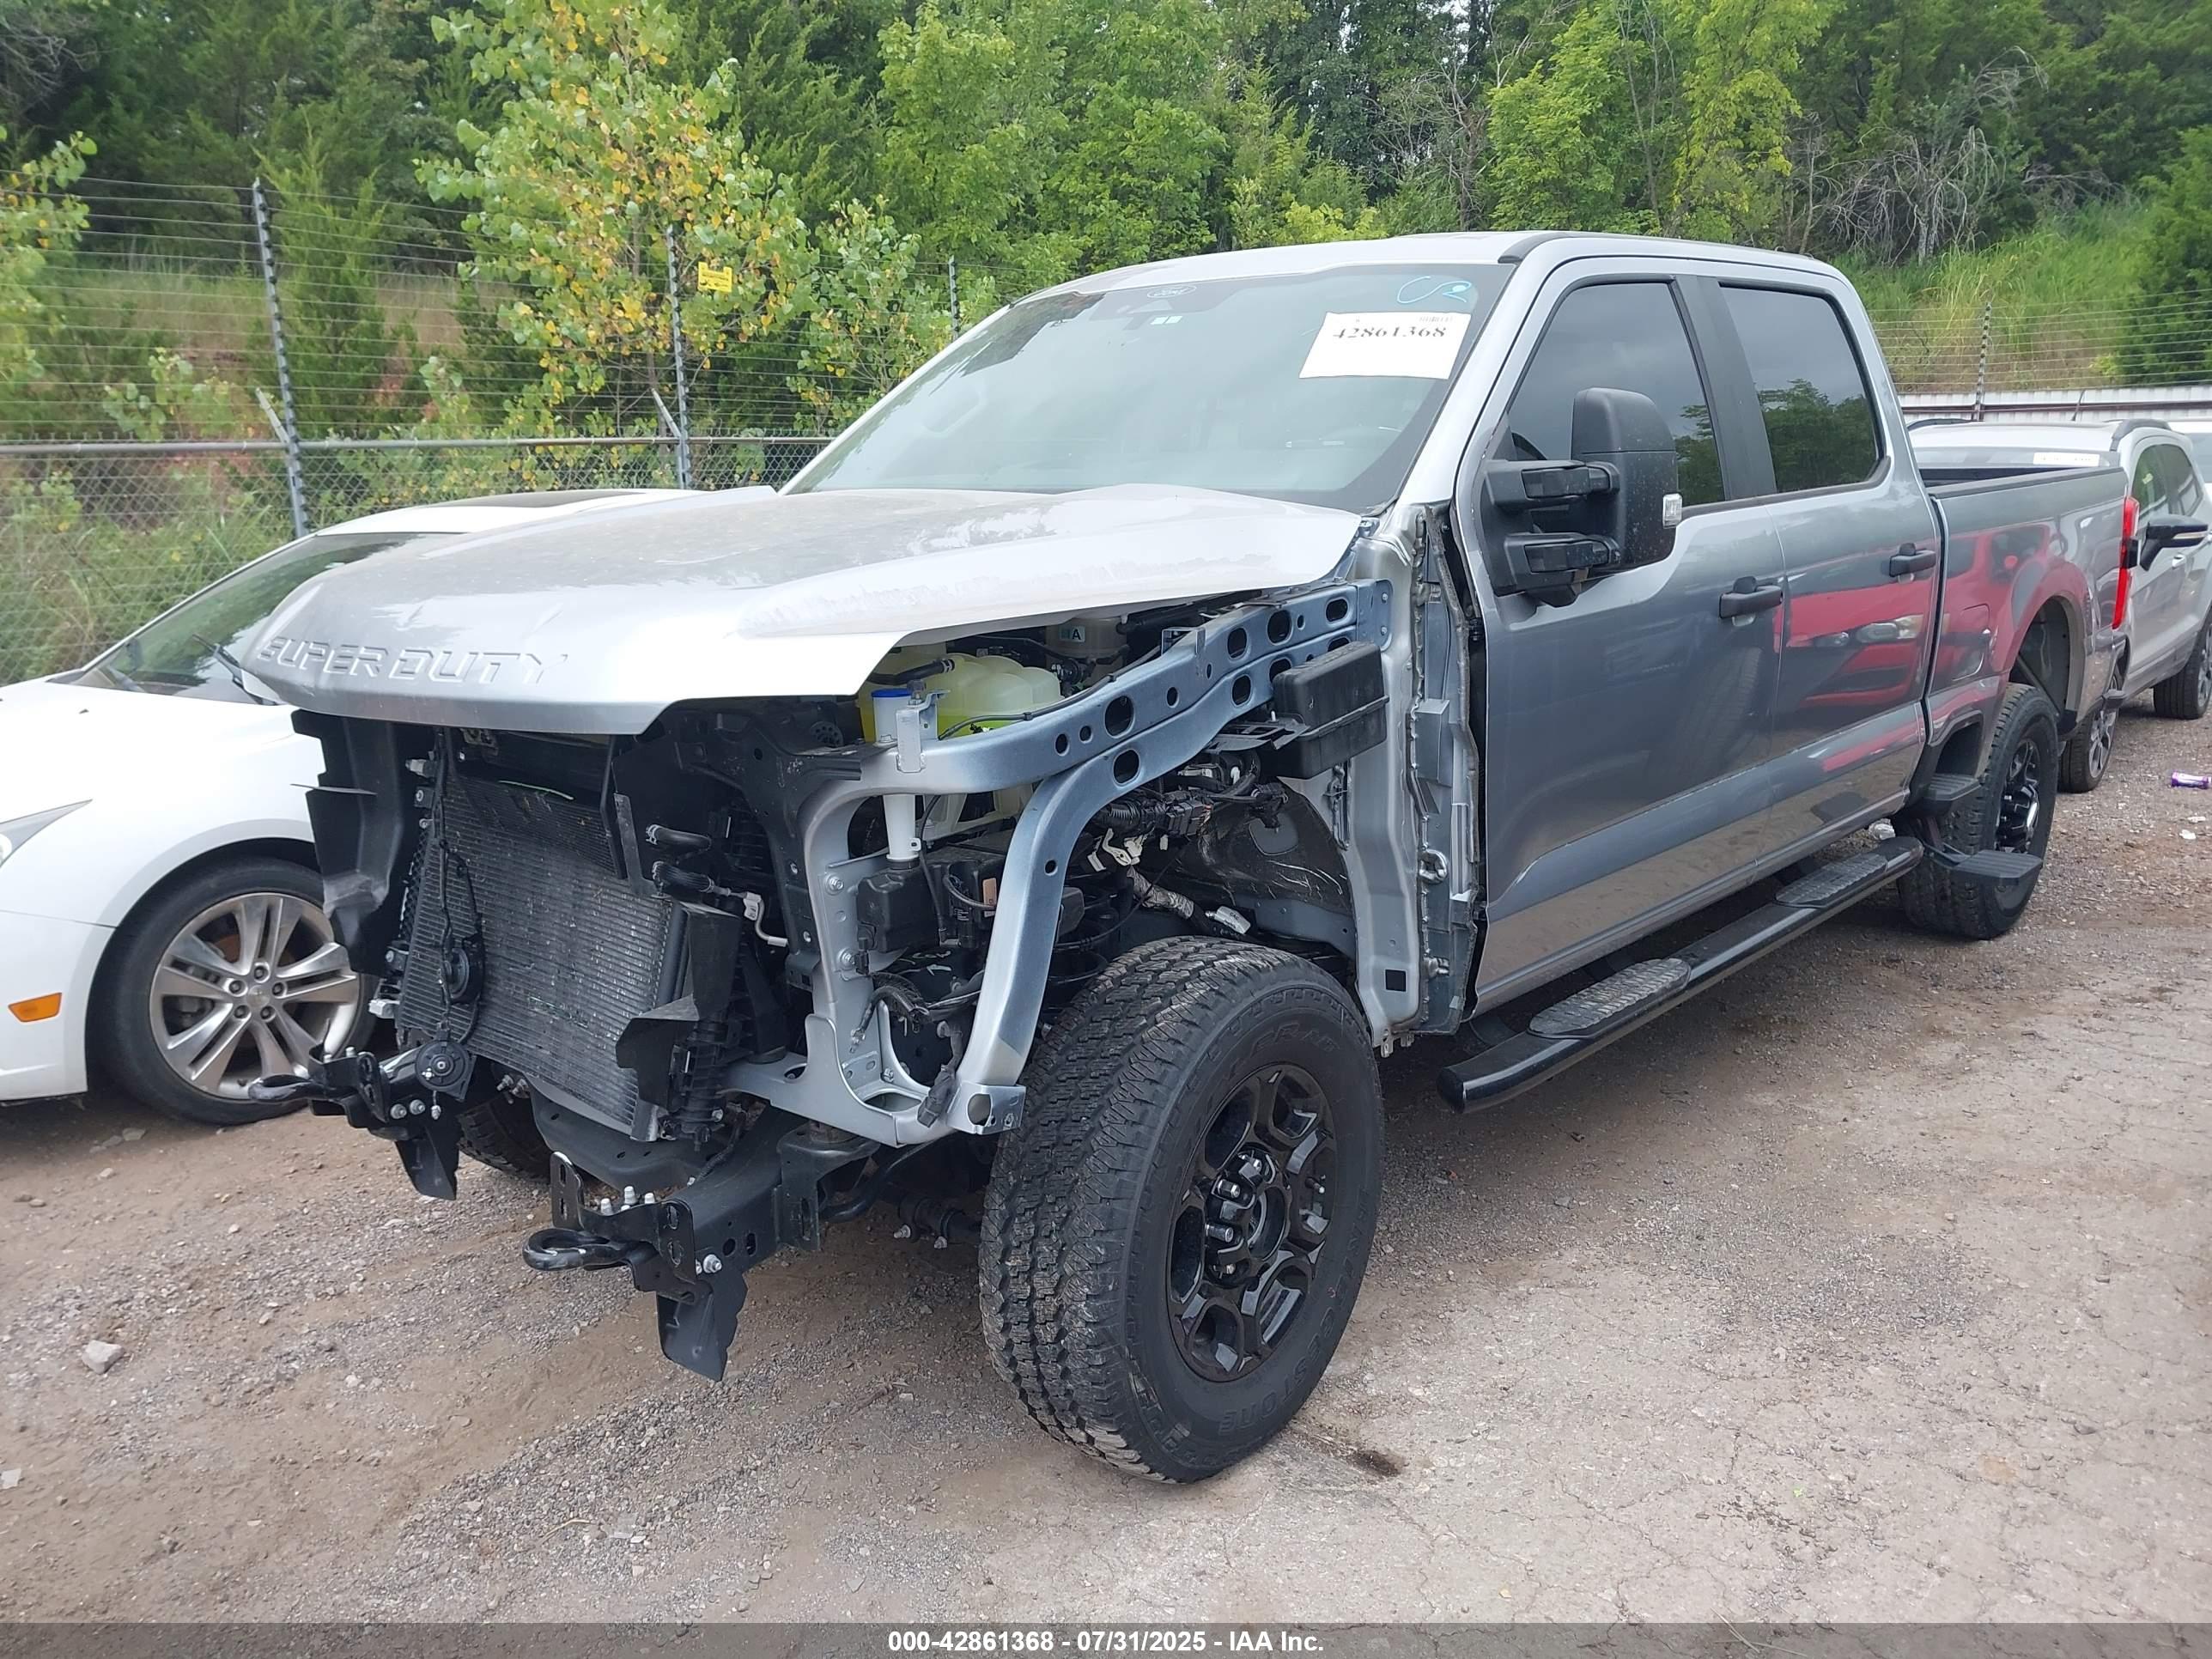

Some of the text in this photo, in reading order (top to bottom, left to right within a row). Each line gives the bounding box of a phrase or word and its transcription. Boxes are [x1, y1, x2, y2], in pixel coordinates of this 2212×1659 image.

[1333, 325, 1447, 338] 42861368
[258, 636, 568, 685] SUPER DUTY
